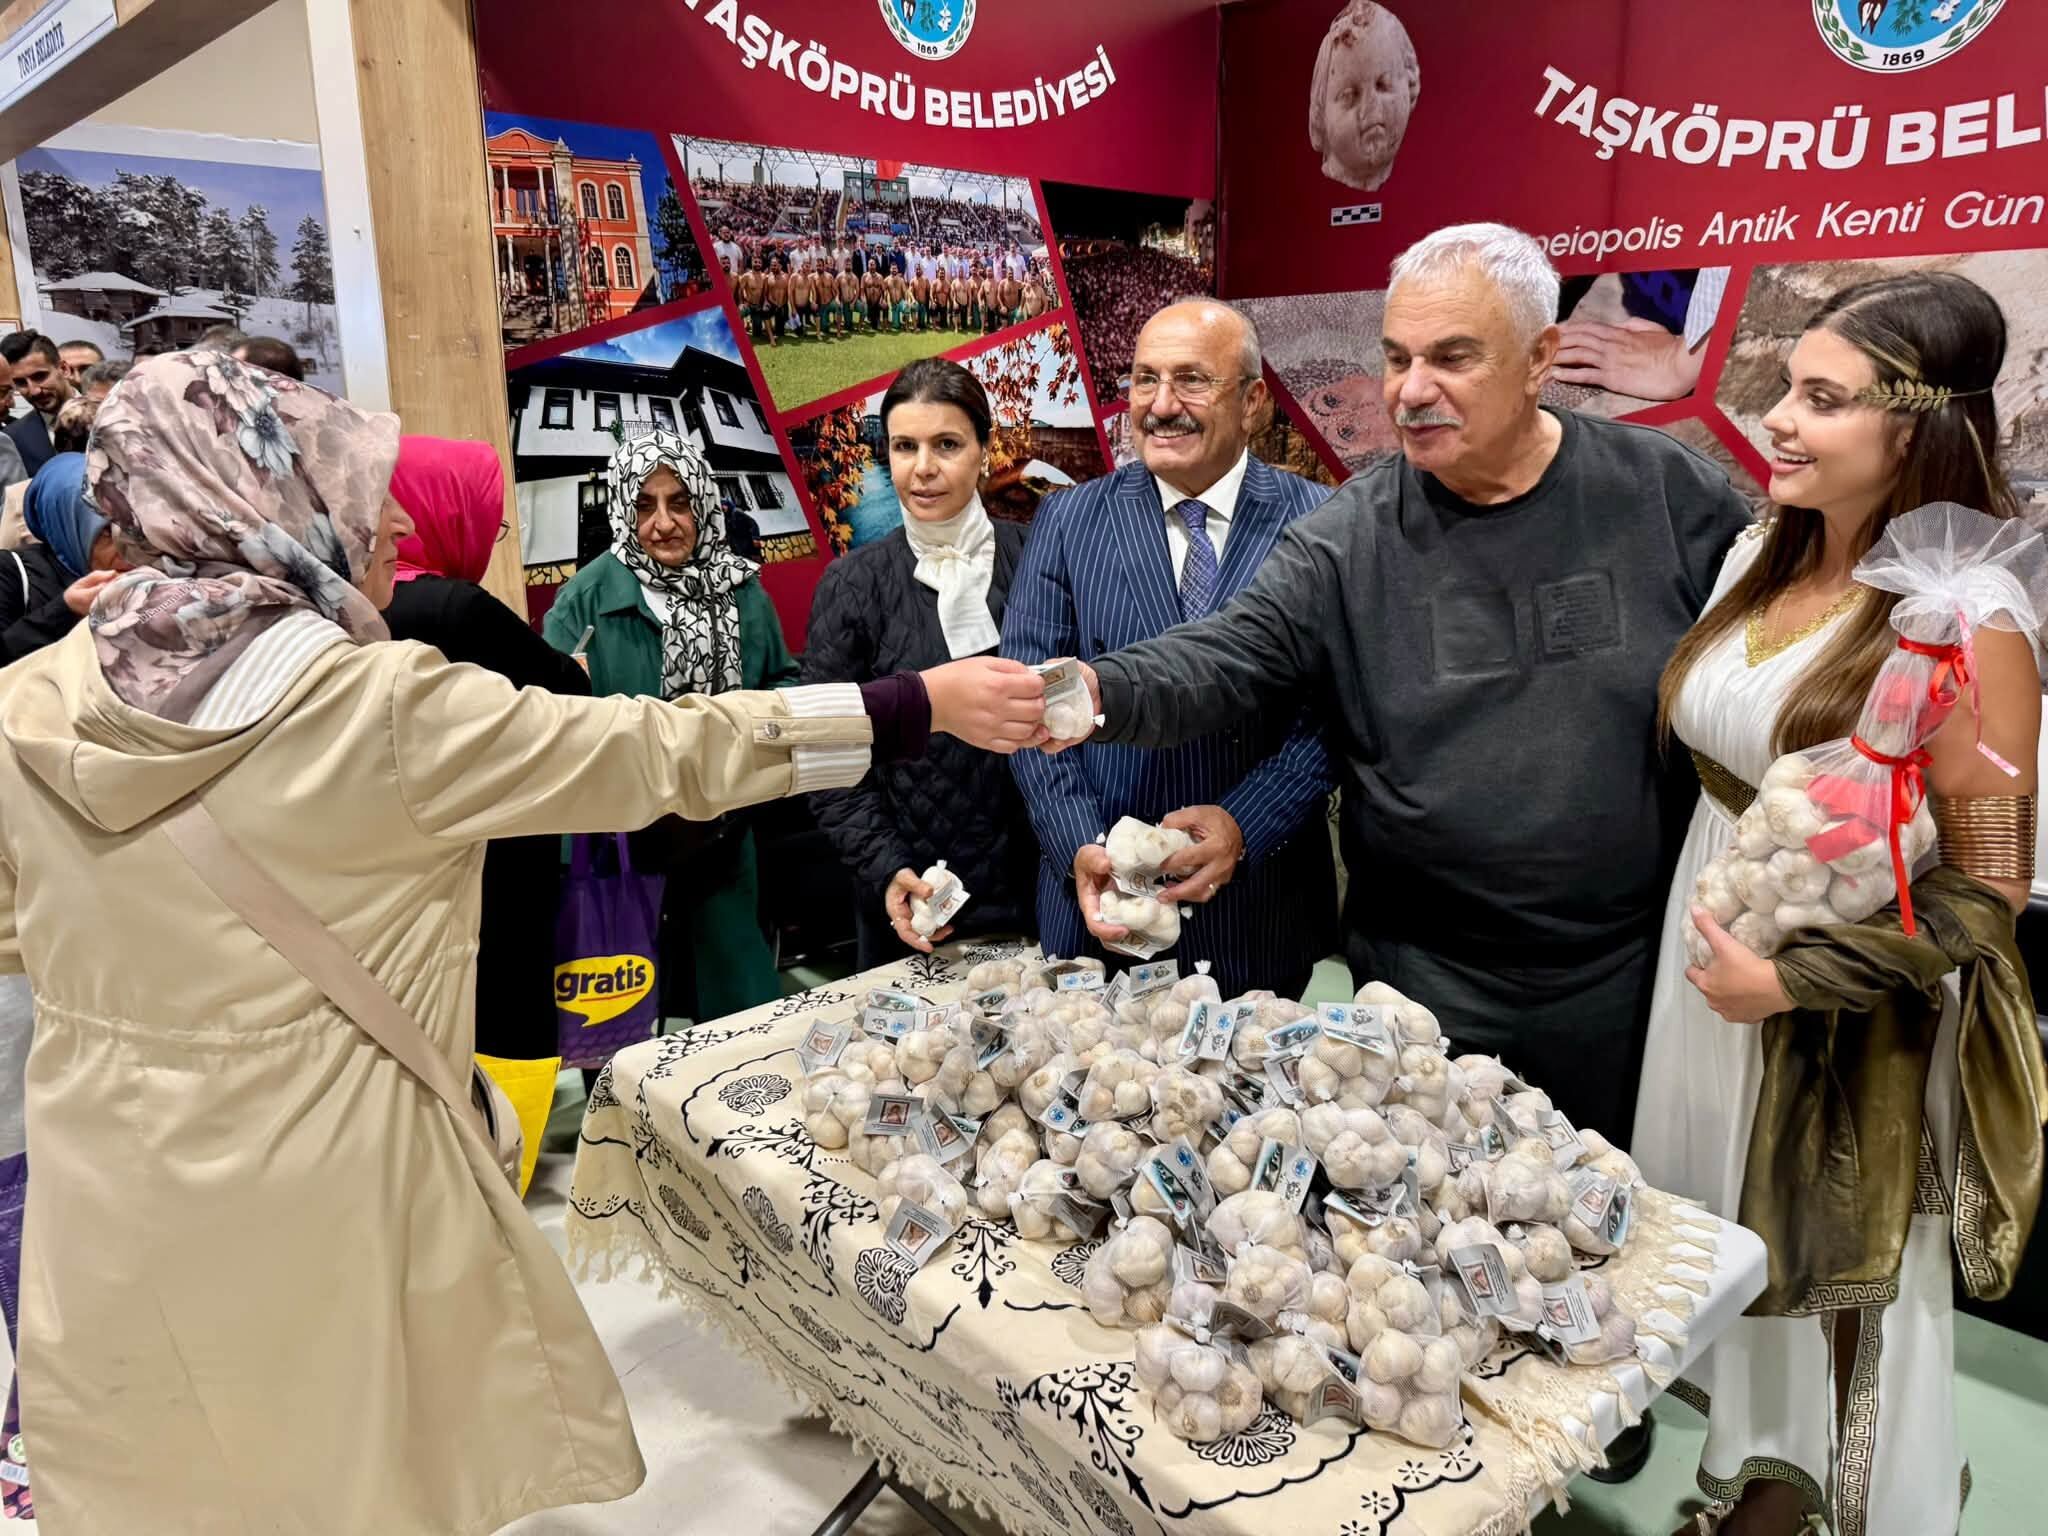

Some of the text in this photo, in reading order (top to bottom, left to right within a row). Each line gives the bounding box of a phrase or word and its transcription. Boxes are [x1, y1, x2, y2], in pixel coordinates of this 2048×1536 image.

[684, 0, 1117, 129] AŞKÖPRÜ BELEDİYESİ
[1881, 49, 1925, 66] 1869
[1533, 64, 2048, 170] TAŞKÖPRÜ BEL
[1699, 205, 1800, 246] Antik
[1816, 198, 1926, 239] Kenti
[1944, 190, 2046, 230] Gün
[556, 959, 647, 1002] gratis
